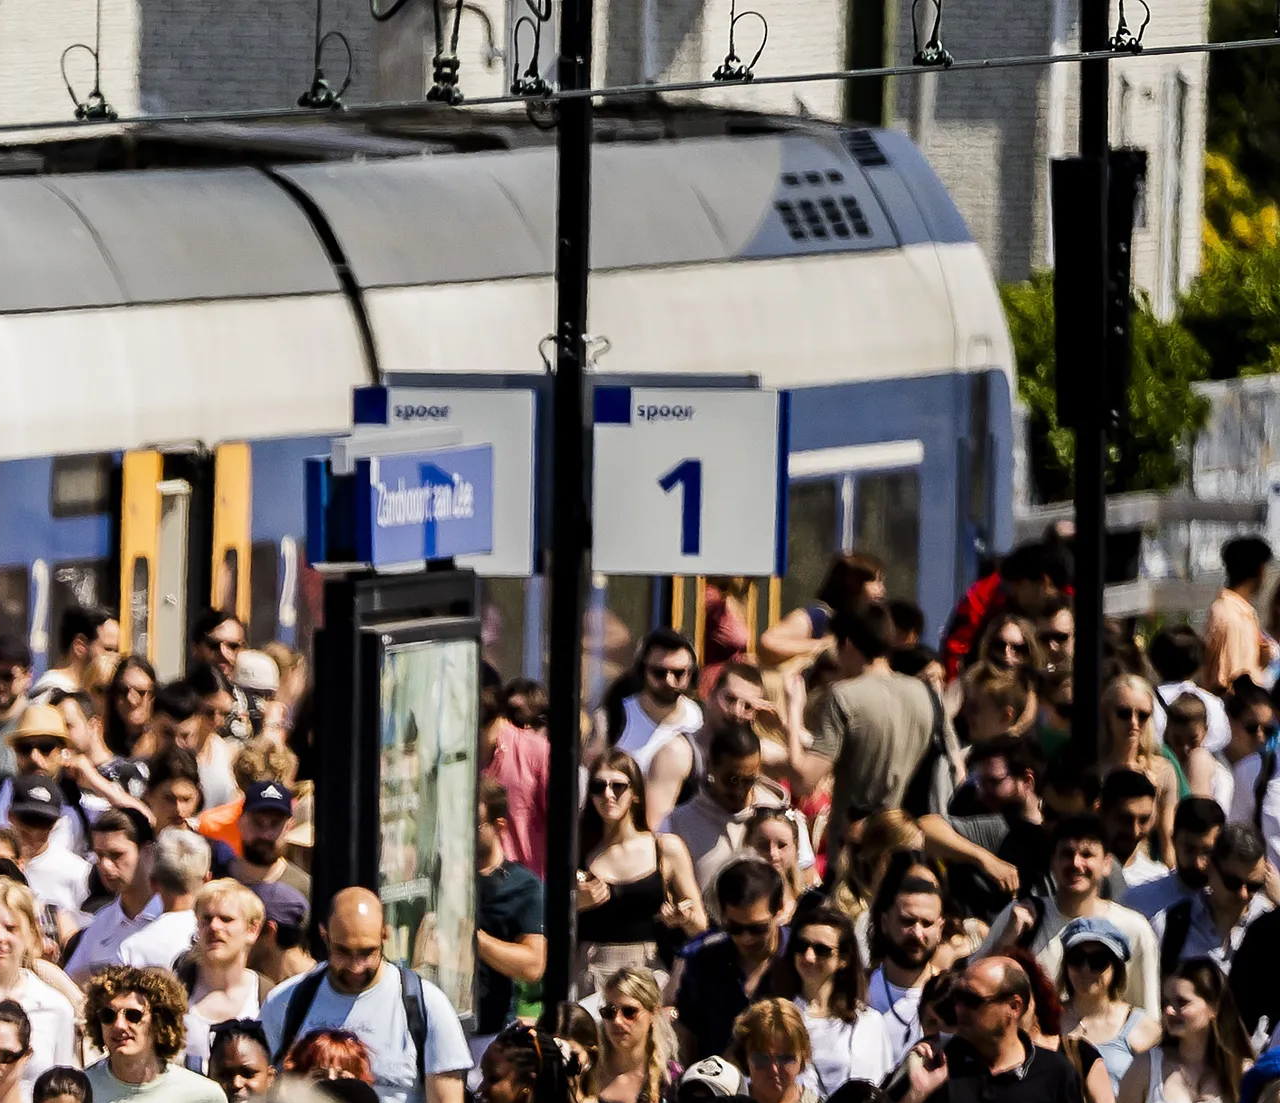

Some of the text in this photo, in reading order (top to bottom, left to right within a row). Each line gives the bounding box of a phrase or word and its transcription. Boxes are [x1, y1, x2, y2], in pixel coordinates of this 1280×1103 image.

[394, 404, 450, 421] spoor
[637, 404, 693, 421] spoor
[377, 471, 475, 527] Zandvoort aan Zee
[658, 459, 702, 556] 1
